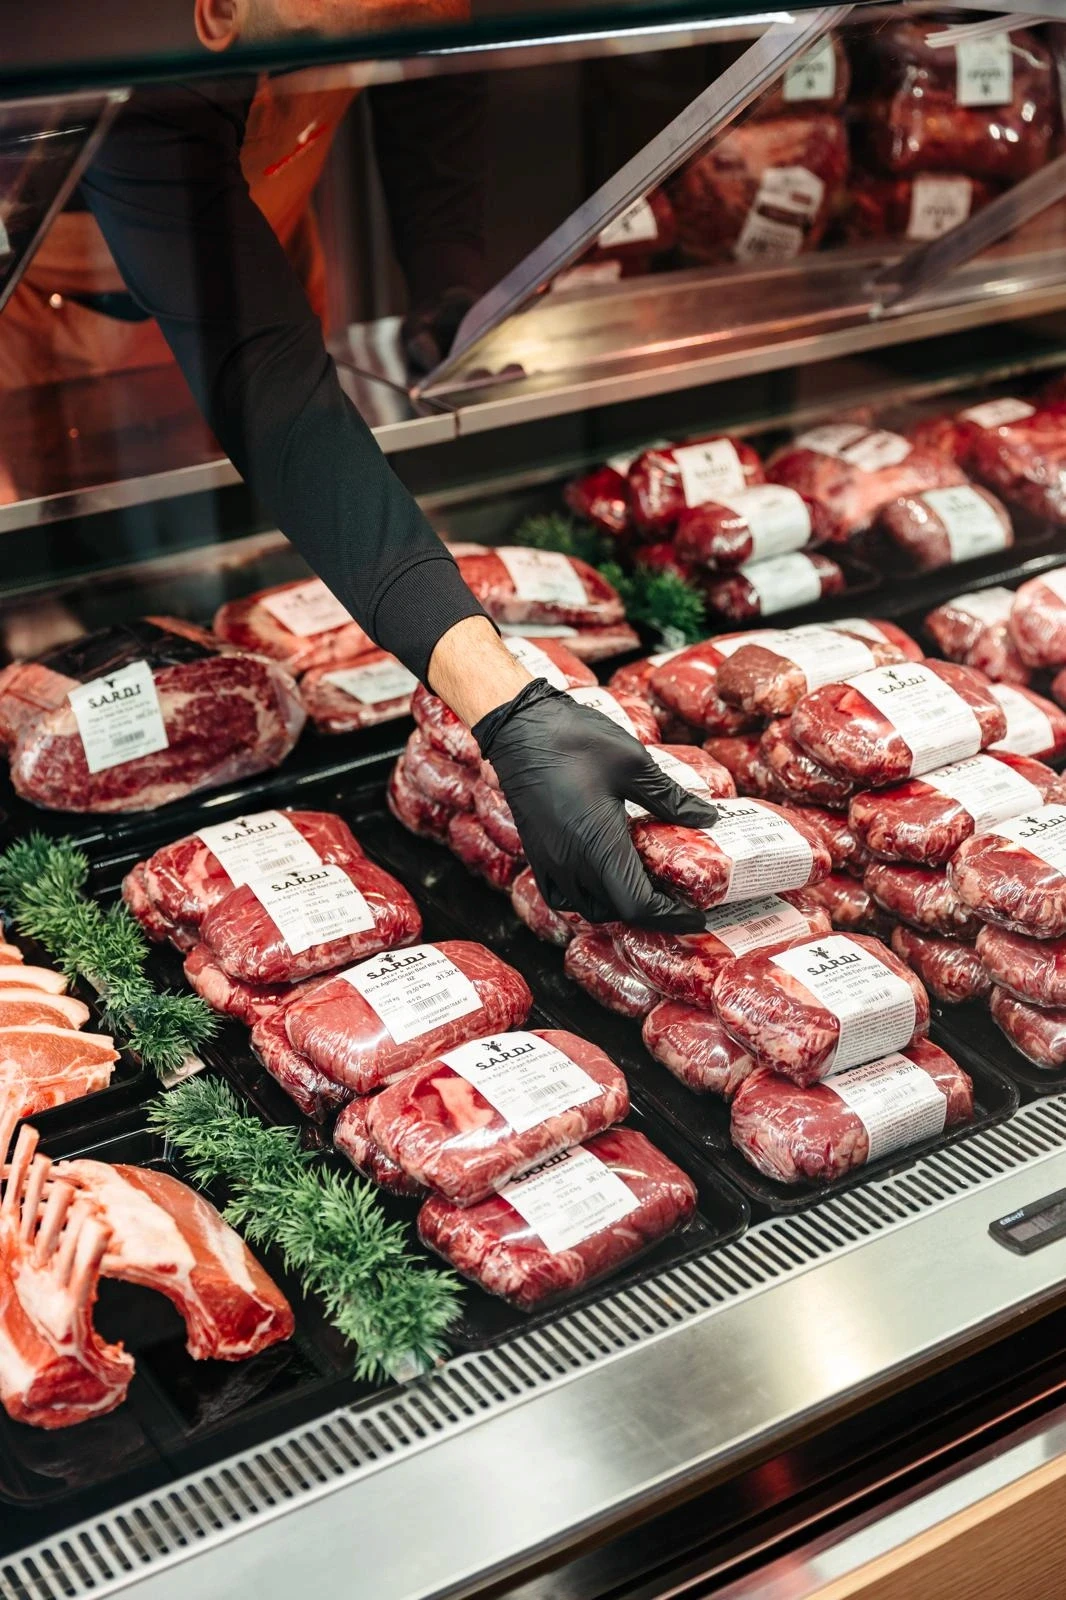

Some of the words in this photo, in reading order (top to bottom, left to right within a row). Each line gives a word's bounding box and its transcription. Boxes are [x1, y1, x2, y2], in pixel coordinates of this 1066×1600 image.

[877, 675, 927, 694] SARDI
[88, 684, 141, 709] SARDI
[221, 822, 278, 842] SARDI
[271, 870, 330, 892] SARDI
[366, 952, 427, 980] SARDI
[435, 970, 455, 981] 31,32
[807, 953, 862, 976] SARDI
[475, 1043, 536, 1070] SARDI
